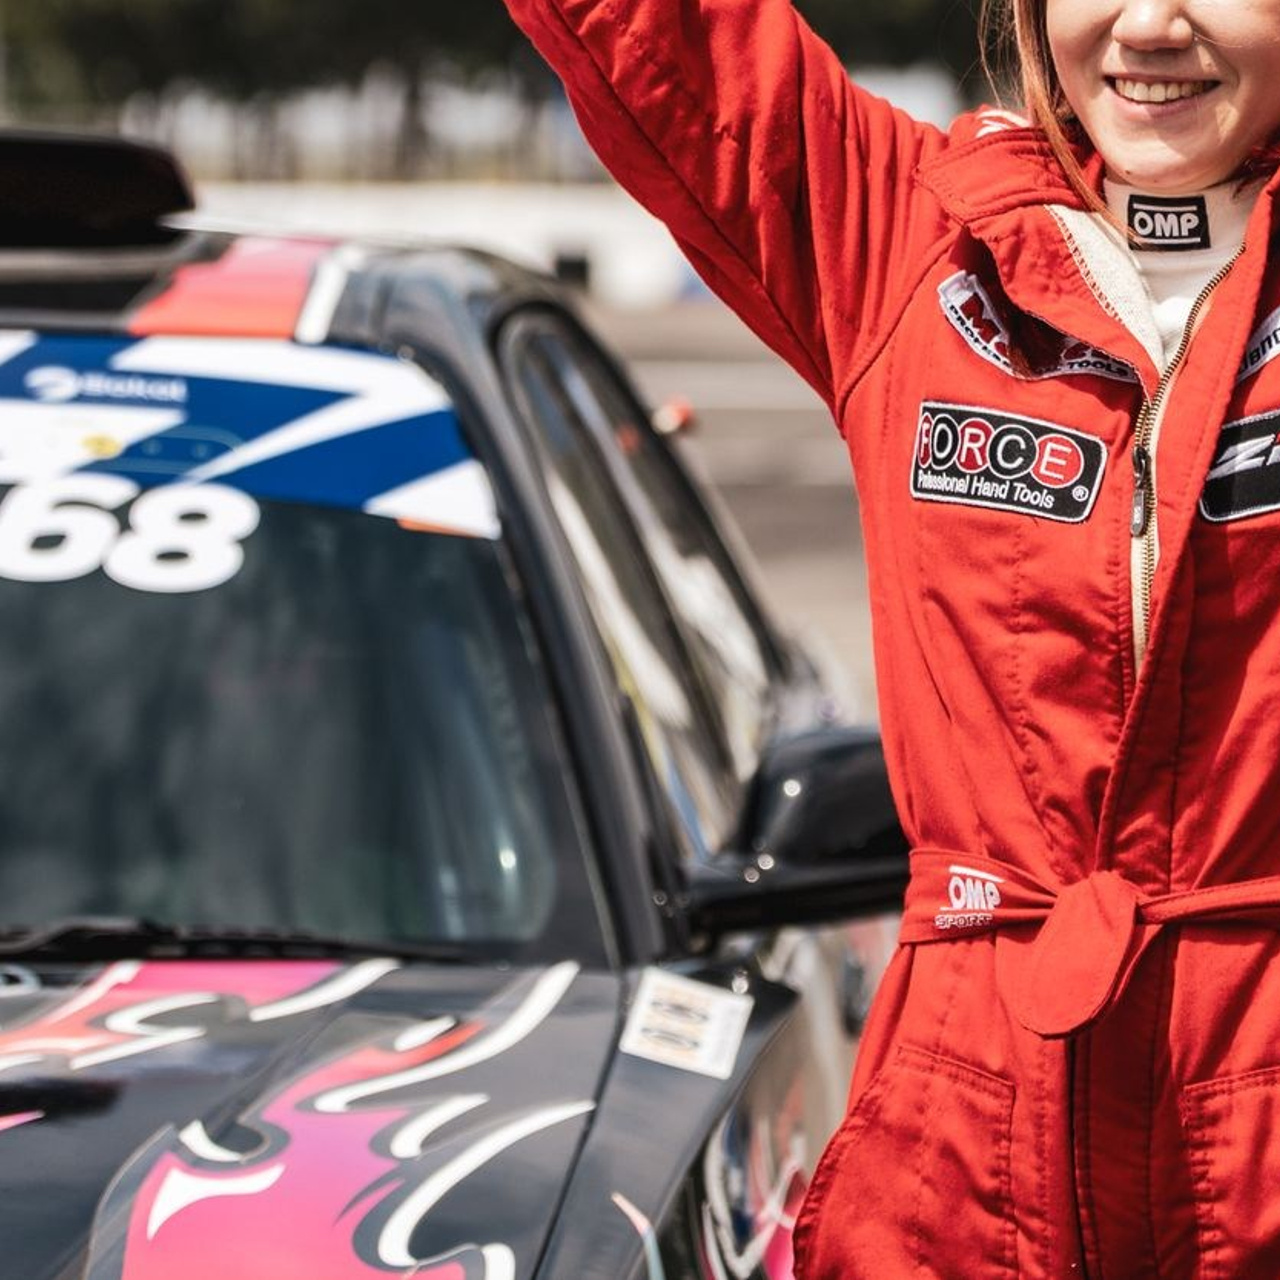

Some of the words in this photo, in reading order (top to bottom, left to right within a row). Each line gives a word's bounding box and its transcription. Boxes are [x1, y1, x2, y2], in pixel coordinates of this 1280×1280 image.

[1132, 210, 1200, 238] OMP
[1066, 359, 1129, 378] TOOLS
[918, 419, 1075, 483] FORCE
[970, 475, 1011, 501] Hand
[1012, 482, 1056, 509] Tools
[948, 875, 1001, 910] OMP
[934, 912, 994, 930] SPORT
